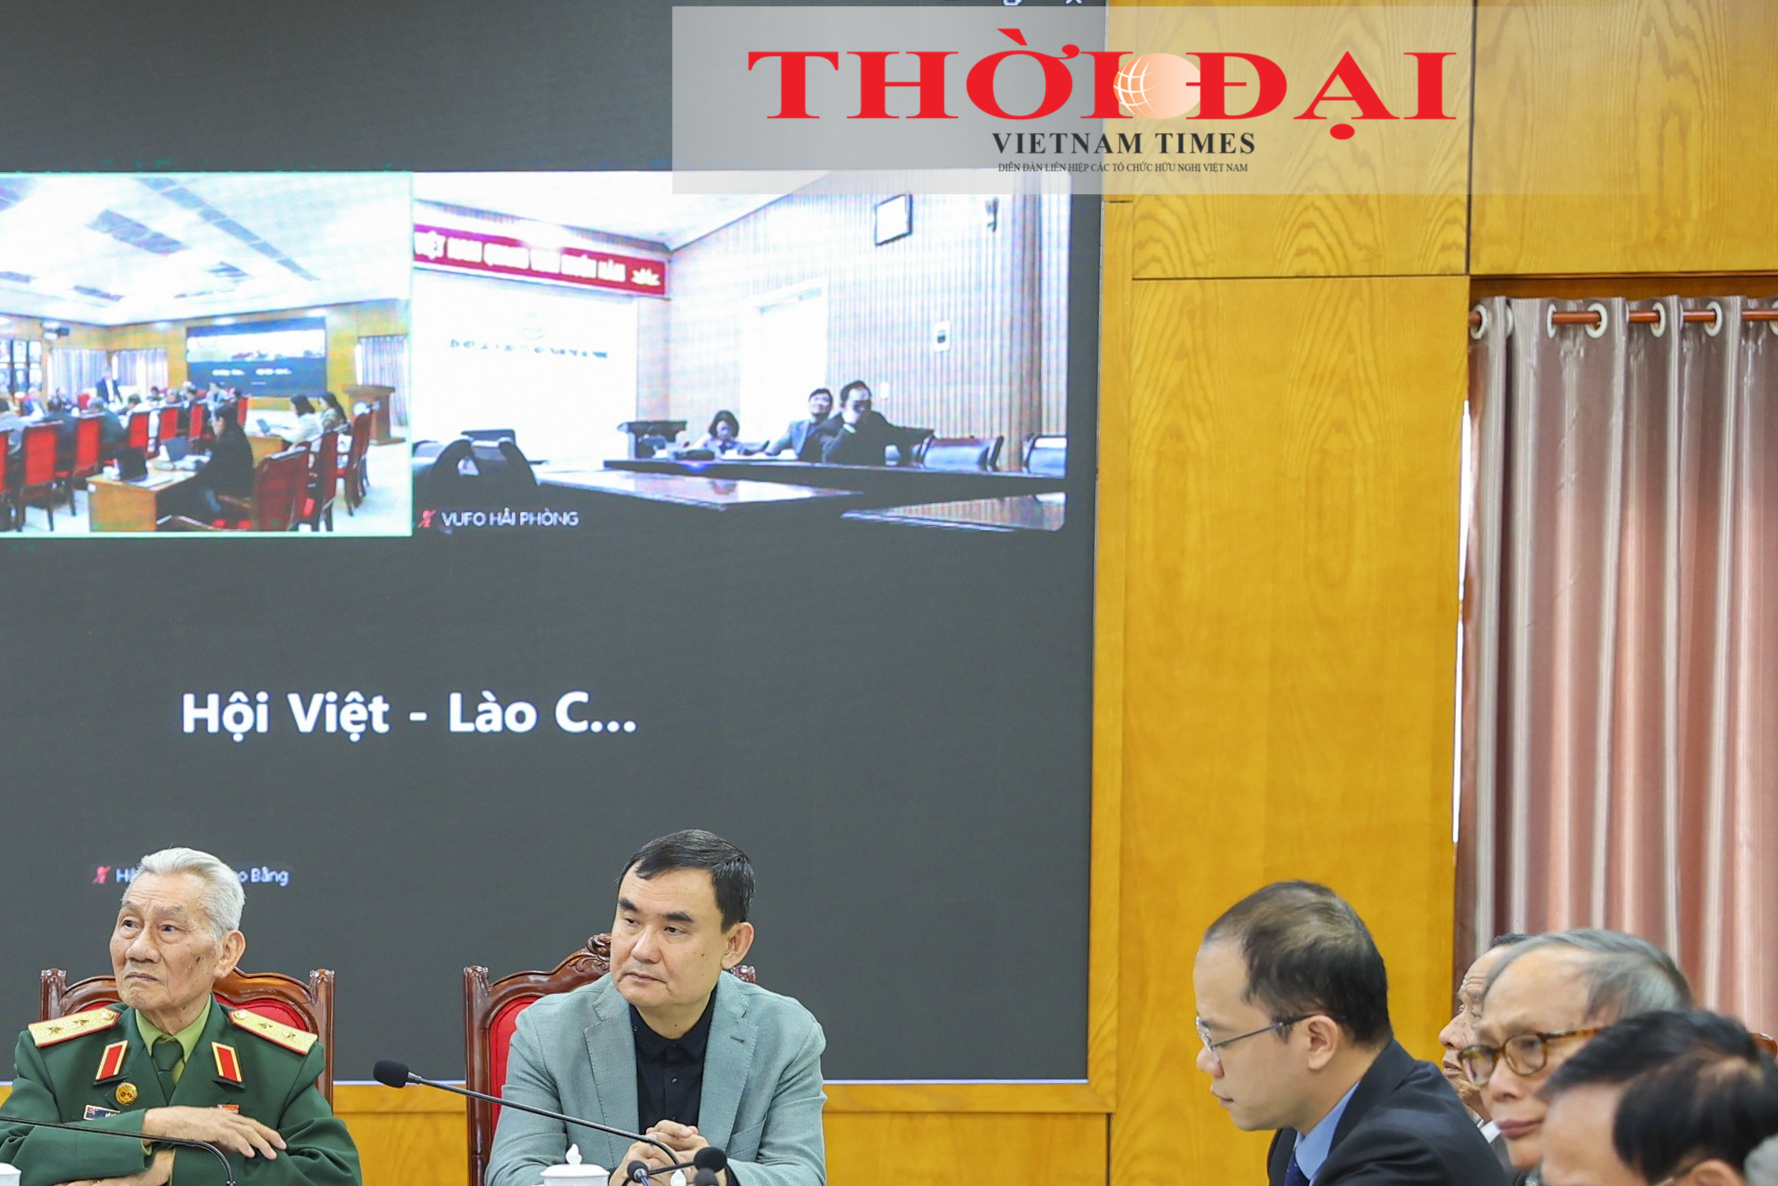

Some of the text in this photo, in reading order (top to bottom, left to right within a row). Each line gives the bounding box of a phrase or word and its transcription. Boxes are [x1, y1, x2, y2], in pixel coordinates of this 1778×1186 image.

[441, 507, 580, 526] VUFO HẢI PHÒNG
[182, 690, 270, 743] Hội
[287, 690, 390, 743] Việt
[449, 690, 538, 733] Lào
[555, 691, 637, 734] C...
